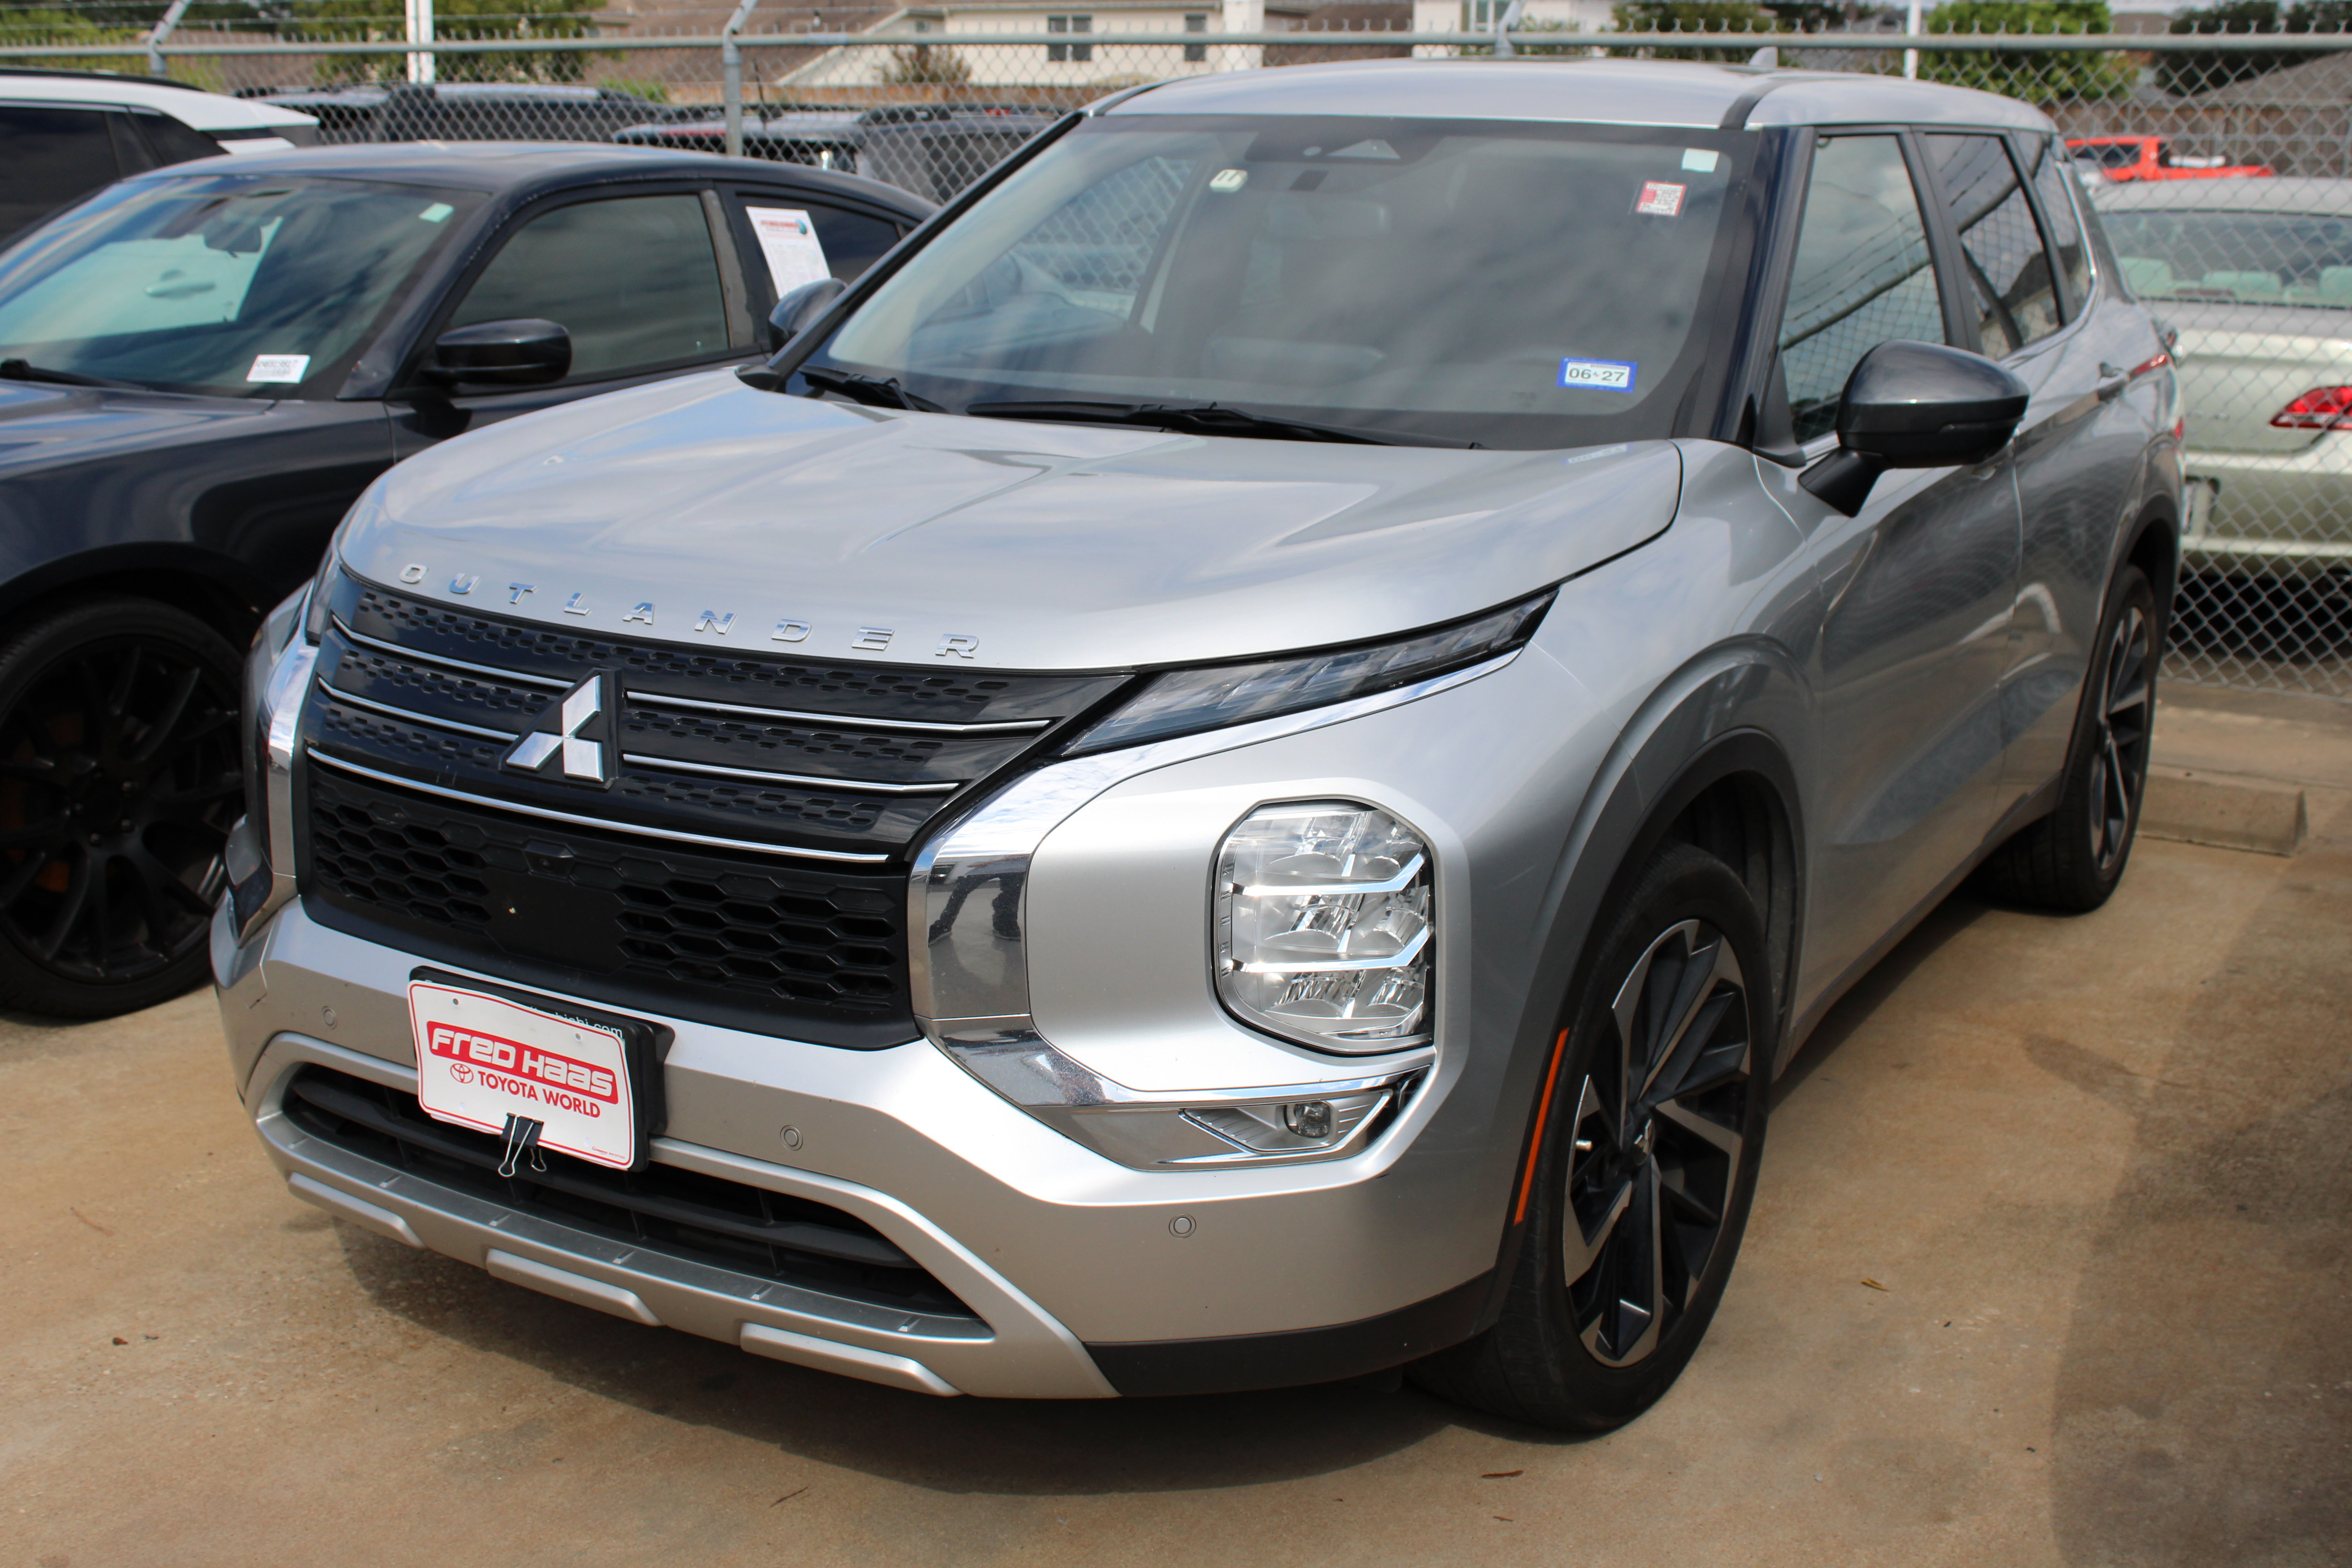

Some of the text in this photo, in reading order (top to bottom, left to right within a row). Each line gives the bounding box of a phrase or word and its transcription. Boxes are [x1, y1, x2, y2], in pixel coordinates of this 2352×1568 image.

[1568, 368, 1625, 382] 06 27
[399, 563, 980, 658] OUTLANDER
[478, 1071, 600, 1118] TOYOTA WORLD
